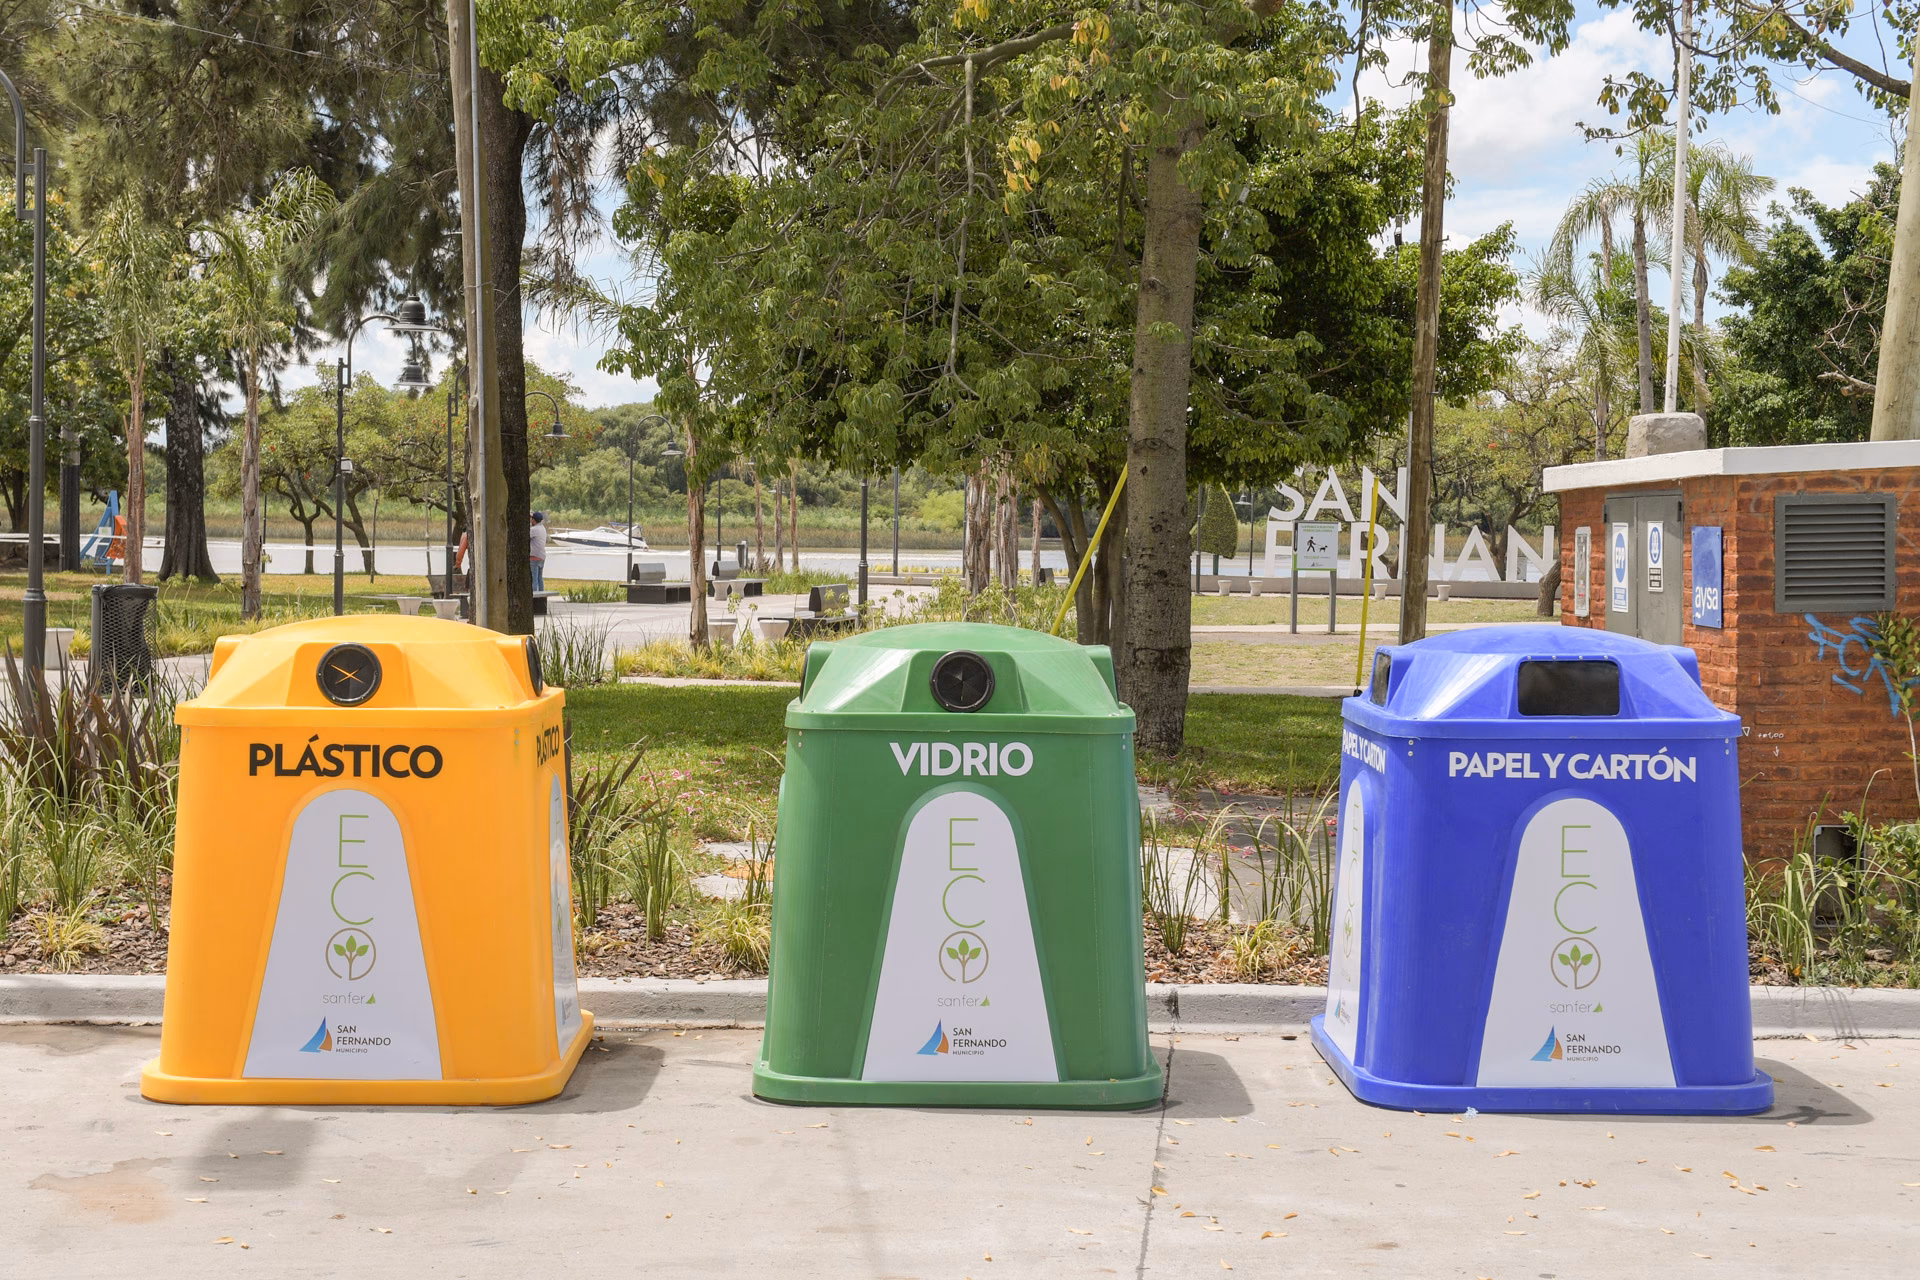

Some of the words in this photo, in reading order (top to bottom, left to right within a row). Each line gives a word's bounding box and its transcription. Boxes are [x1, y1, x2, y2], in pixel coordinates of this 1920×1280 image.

[1269, 465, 1407, 521] SAN
[1615, 547, 1625, 569] EPP
[1695, 586, 1719, 616] aysa
[249, 734, 443, 778] PLÁSTICO
[889, 742, 1034, 777] VIDRIO
[1449, 751, 1540, 778] PAPEL
[1542, 753, 1565, 778] Y
[1567, 746, 1697, 783] CARTÓN
[325, 814, 376, 981] ECO
[939, 817, 989, 984] ECO
[1550, 825, 1601, 990] ECO
[336, 1036, 391, 1046] FERNANDO
[337, 1024, 357, 1034] SAN
[952, 1027, 972, 1036] SAN
[952, 1039, 1007, 1048] FERNANDO
[1566, 1033, 1586, 1043] SAN
[1566, 1045, 1621, 1054] FERNANDO
